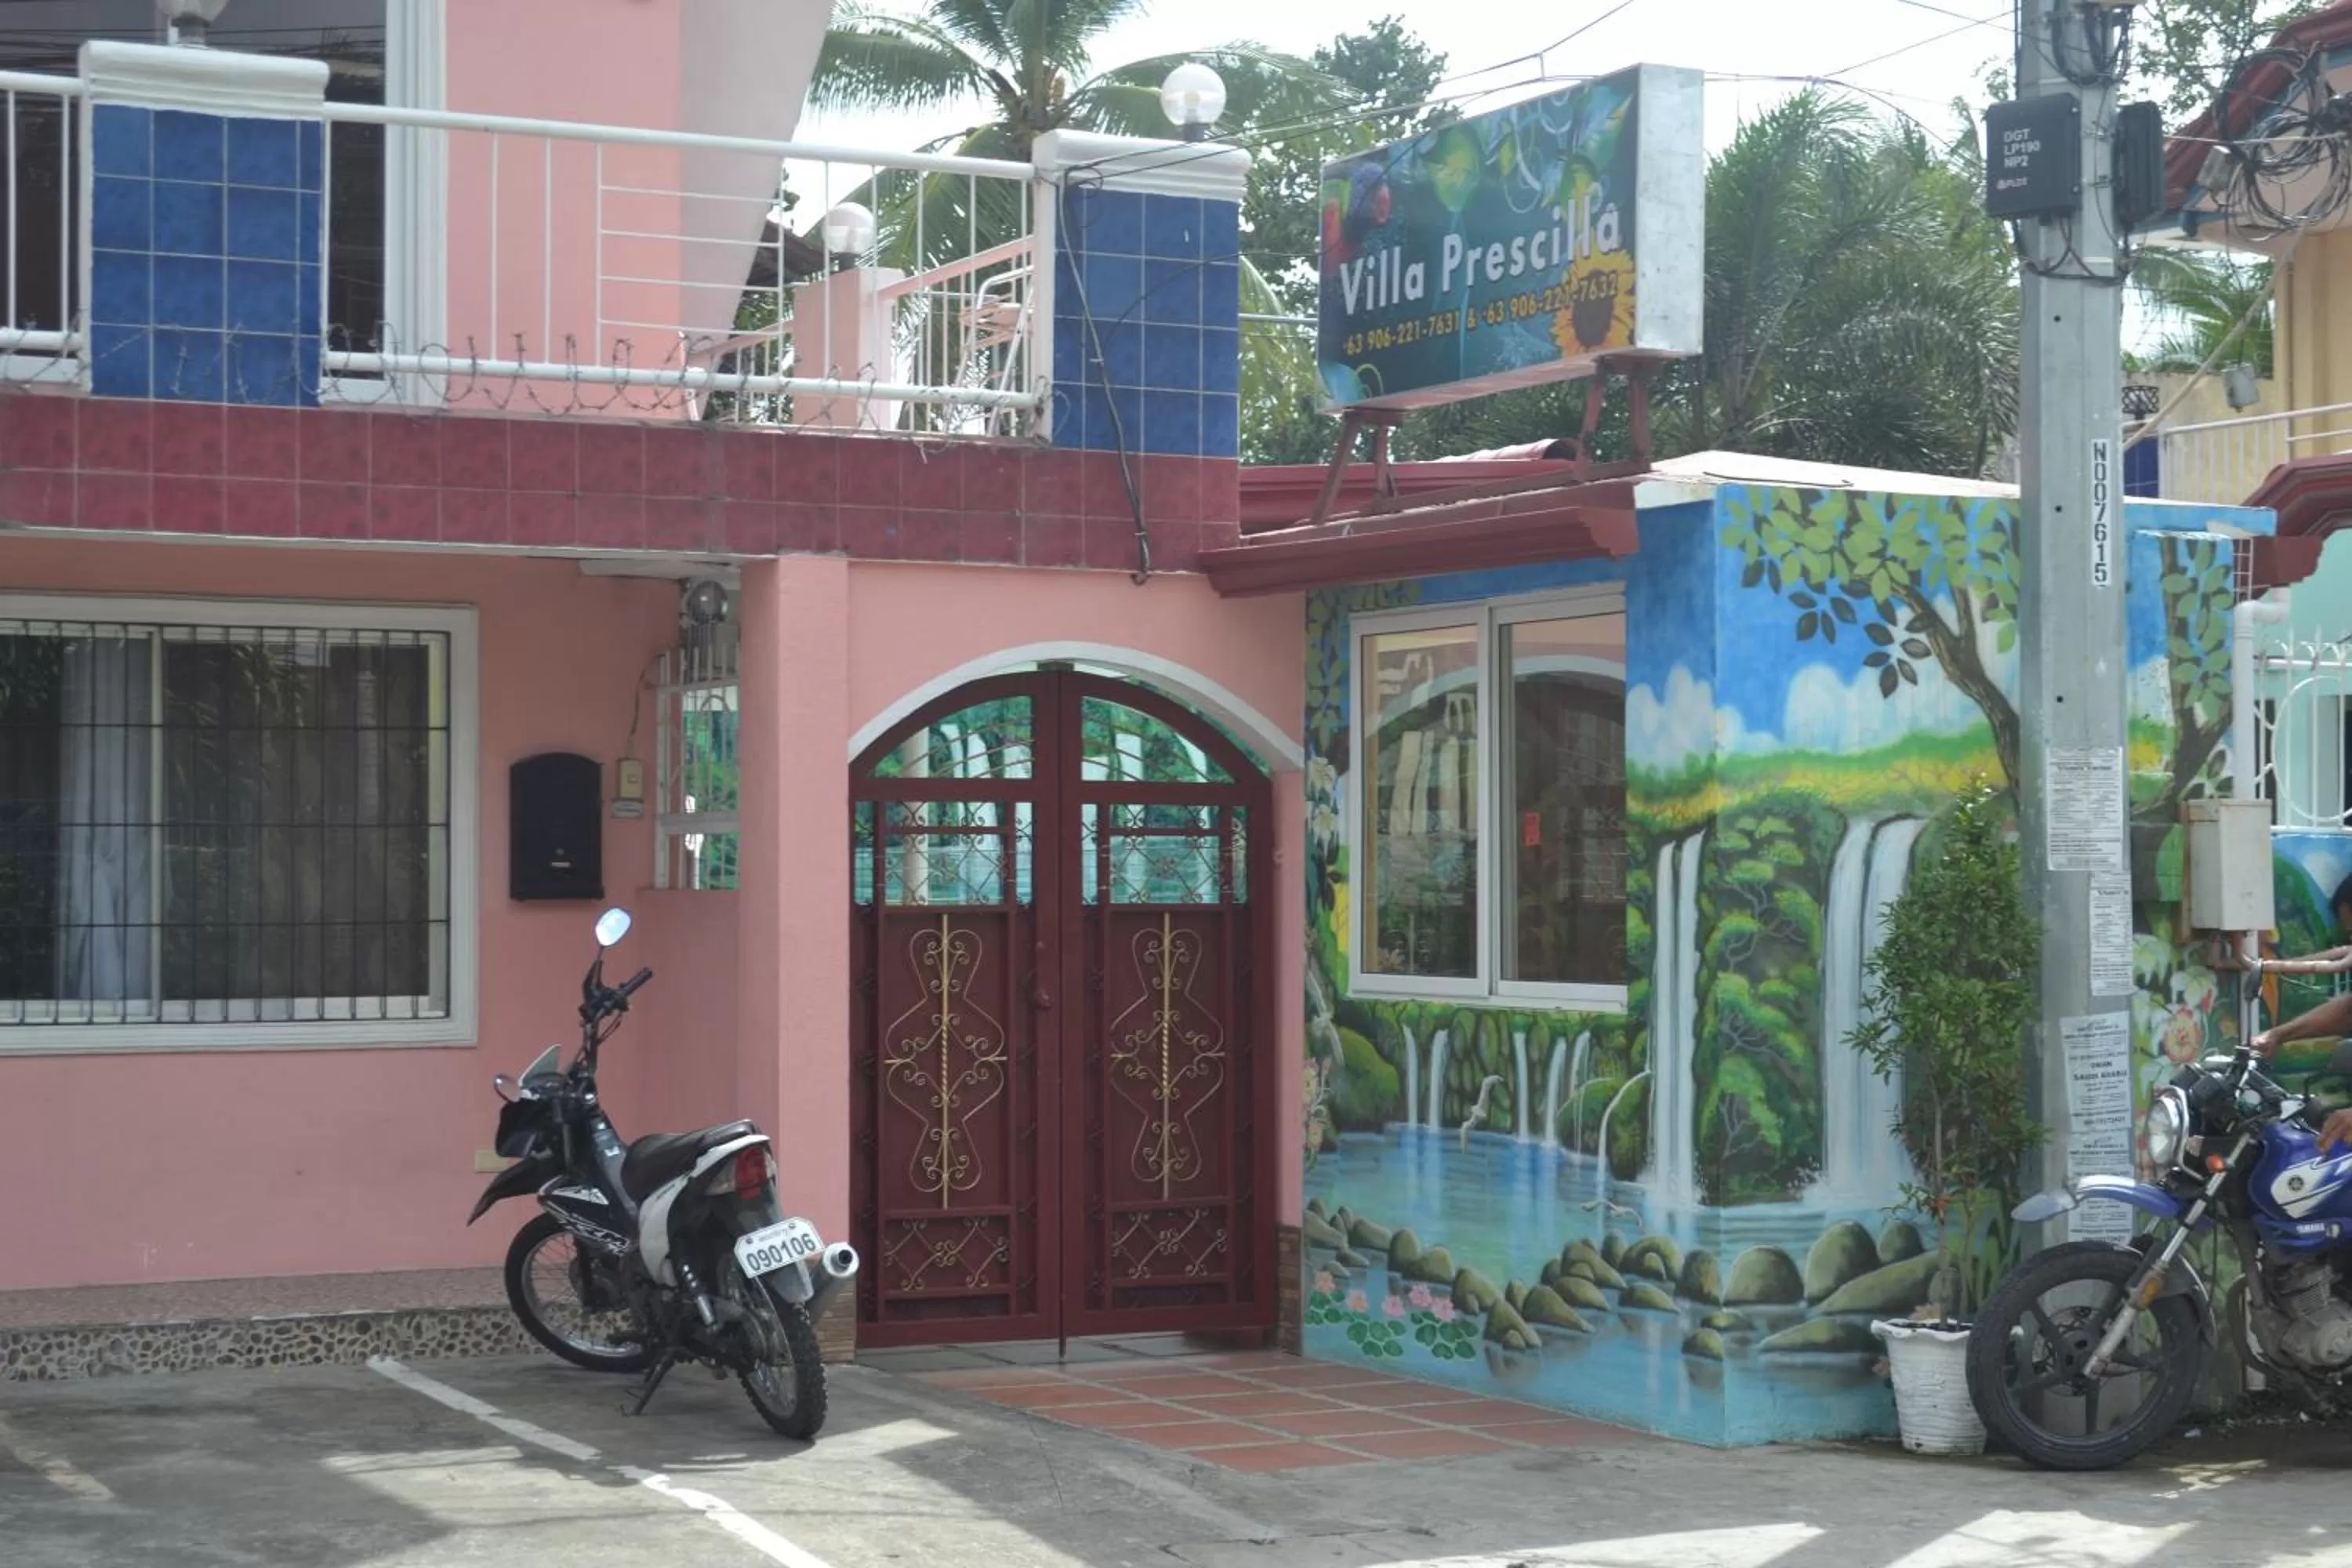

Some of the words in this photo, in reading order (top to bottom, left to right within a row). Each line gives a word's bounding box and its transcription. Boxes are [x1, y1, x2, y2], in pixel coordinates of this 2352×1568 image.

[2004, 129, 2031, 142] DGT
[1340, 245, 1425, 316] Villa
[1443, 194, 1620, 293] Prescilla
[1367, 310, 1459, 351] 906-221-7631
[1467, 307, 1476, 329] &
[2094, 442, 2107, 583] N007615
[746, 1232, 816, 1271] 090106
